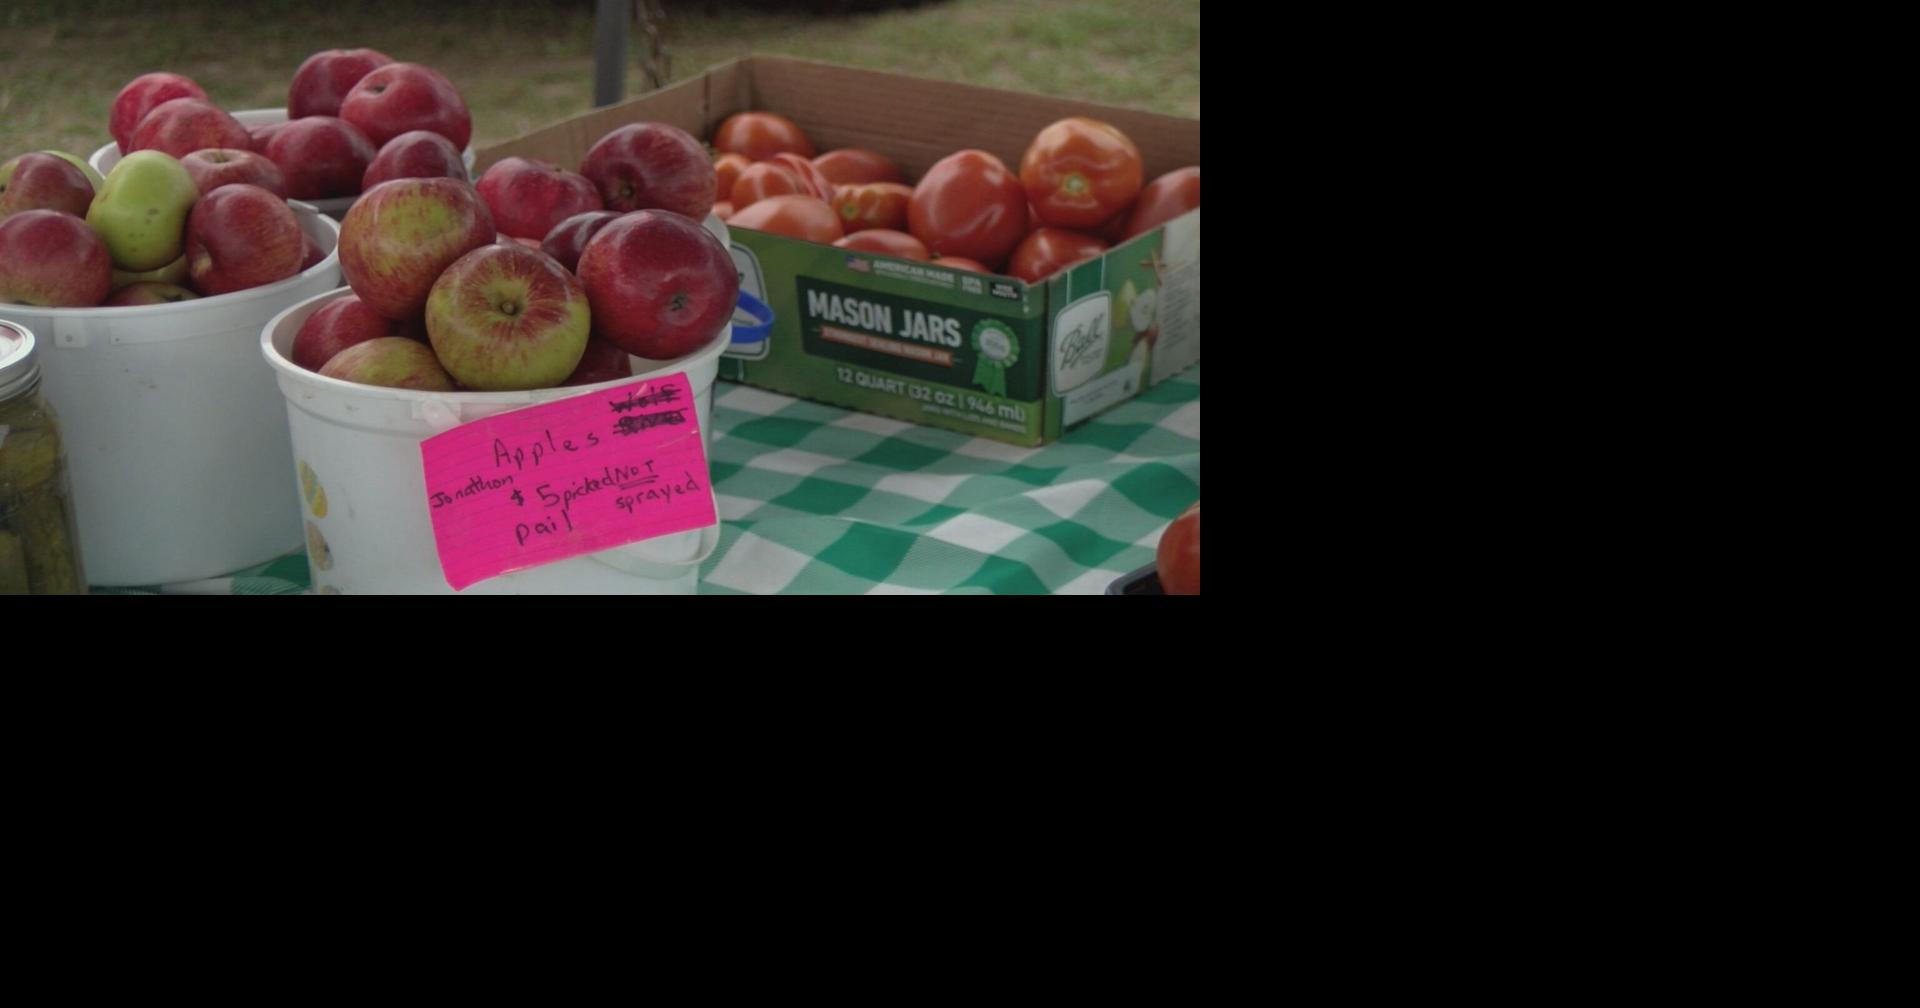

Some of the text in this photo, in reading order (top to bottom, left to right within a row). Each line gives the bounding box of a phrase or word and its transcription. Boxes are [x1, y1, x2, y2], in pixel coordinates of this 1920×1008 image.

[925, 268, 955, 283] MADE
[807, 289, 893, 335] MASON
[898, 310, 962, 348] JARS
[836, 367, 853, 384] 12
[855, 372, 905, 395] QUART
[908, 384, 931, 399] (32
[967, 396, 996, 415] 946
[493, 430, 600, 469] Apples
[615, 471, 701, 514] sprayed
[515, 508, 574, 547] pail
